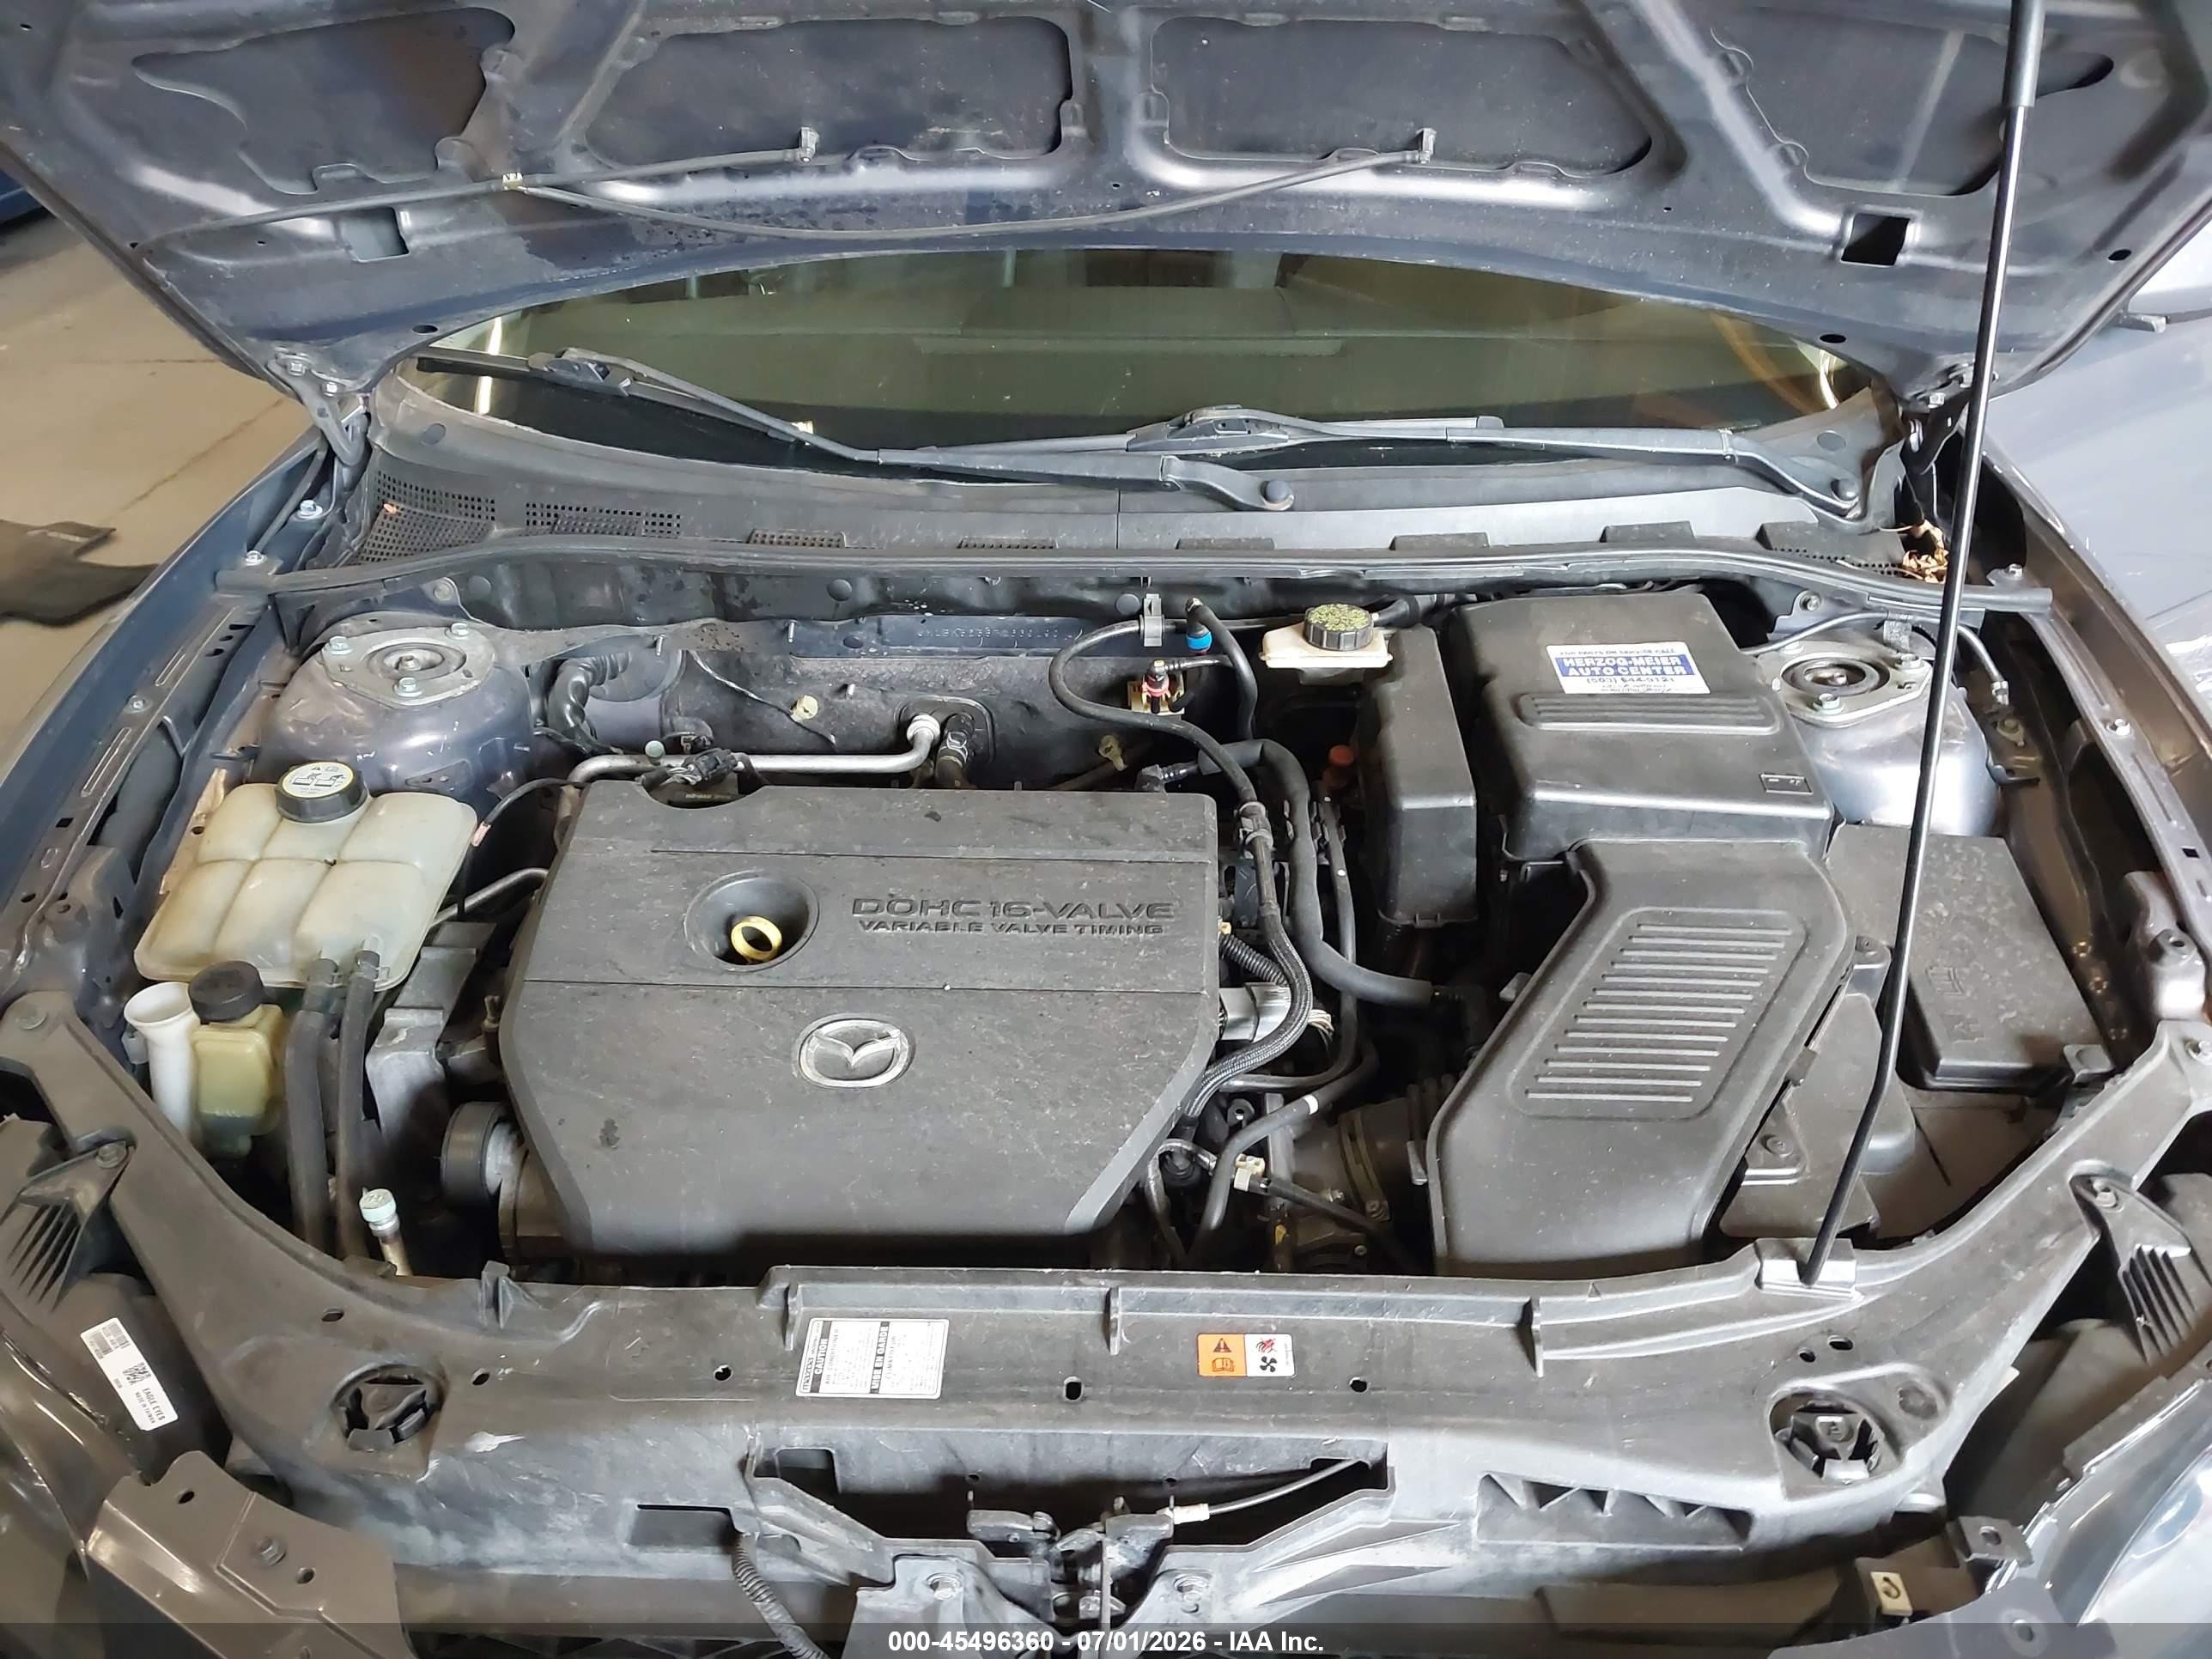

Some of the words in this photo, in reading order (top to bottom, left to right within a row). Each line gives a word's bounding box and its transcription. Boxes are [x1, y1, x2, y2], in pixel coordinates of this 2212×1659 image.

[1563, 655, 1682, 667] HERZOG-MEIER
[1568, 666, 1615, 676] AUTO
[1617, 665, 1687, 676] CENTER
[852, 897, 981, 916] DOHC
[988, 900, 1176, 921] 16-VALVE
[860, 920, 983, 933] VARIABLE
[991, 921, 1068, 934] VALVE
[1074, 923, 1164, 936] TIMING
[878, 1326, 889, 1355] GARDE
[814, 1338, 829, 1375] CAUTION
[874, 1356, 884, 1368] EN
[143, 1388, 157, 1405] EAGLE
[153, 1405, 166, 1420] EYES
